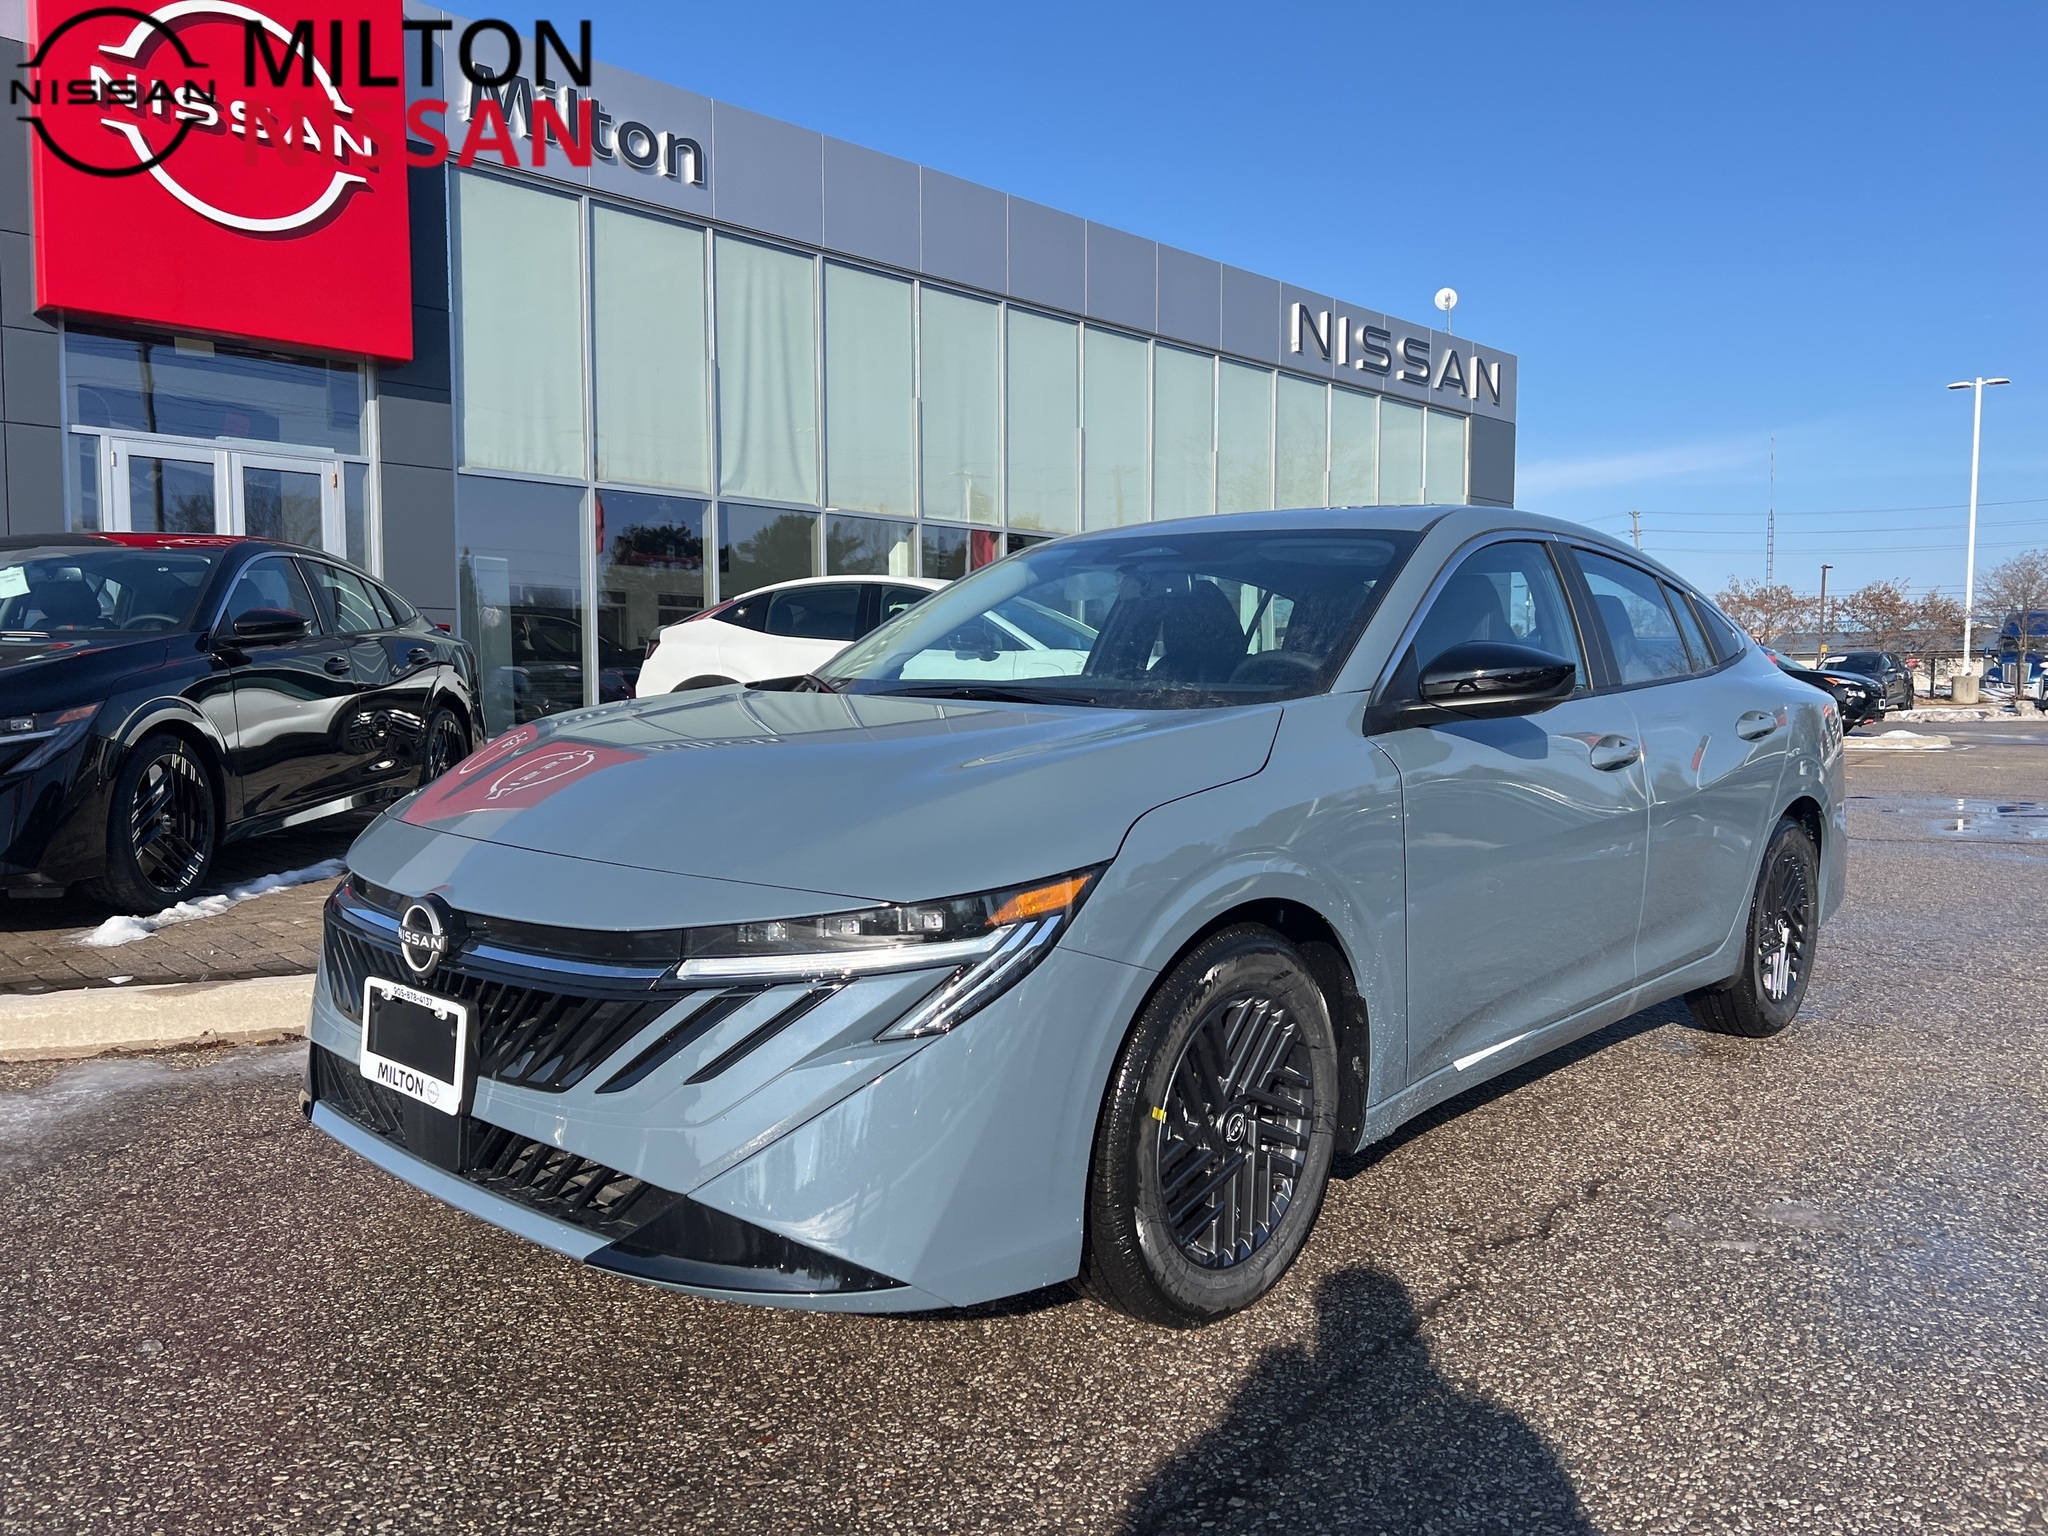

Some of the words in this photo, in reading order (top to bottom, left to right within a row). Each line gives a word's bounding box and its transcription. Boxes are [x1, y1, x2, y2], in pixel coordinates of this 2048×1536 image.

[1291, 302, 1501, 406] NISSAN
[398, 926, 442, 950] NISSAN
[377, 1061, 424, 1097] MILTON
